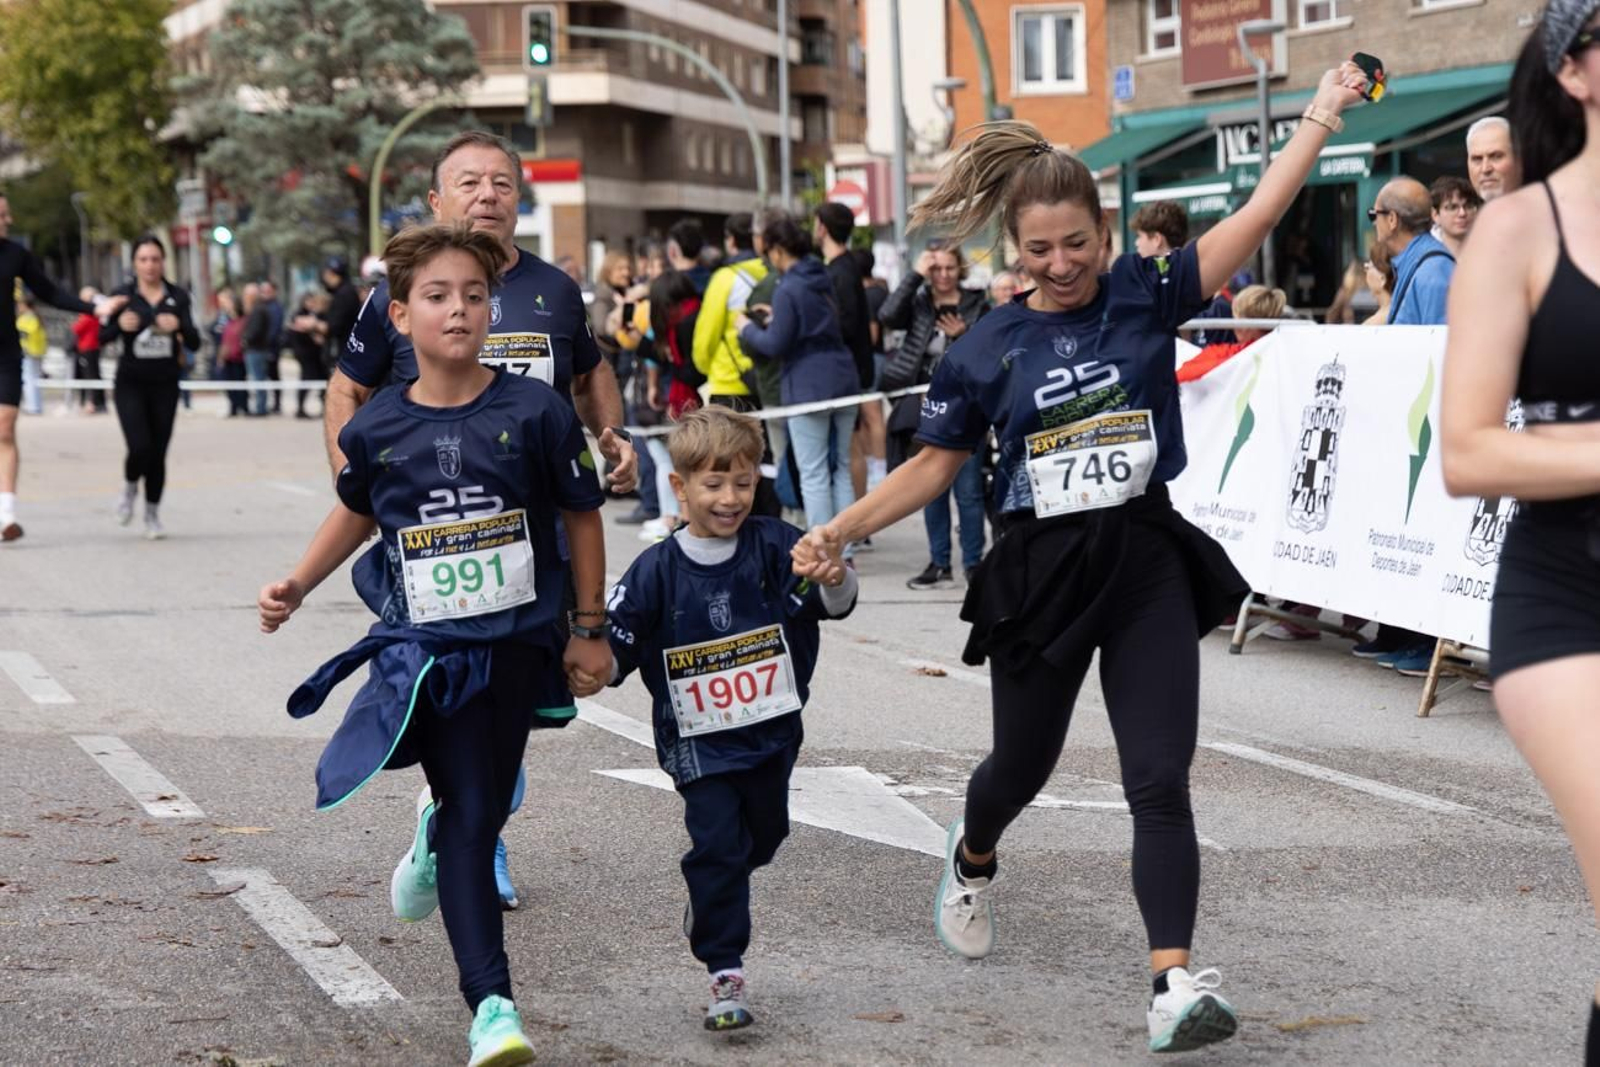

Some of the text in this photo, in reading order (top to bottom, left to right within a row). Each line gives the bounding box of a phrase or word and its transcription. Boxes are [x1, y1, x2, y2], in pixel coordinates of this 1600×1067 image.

[1034, 360, 1120, 410] 25
[1099, 423, 1147, 435] caminata
[1101, 416, 1145, 427] POPULAR
[1053, 450, 1132, 491] 746
[418, 485, 504, 525] 25
[404, 515, 522, 550] XXV CARRERA POPULAR
[434, 523, 522, 546] y gran caminata
[432, 552, 505, 597] 991
[670, 630, 780, 670] XXV CARRERA POPULAR
[696, 638, 780, 665] y gran caminata
[685, 662, 778, 713] 1907
